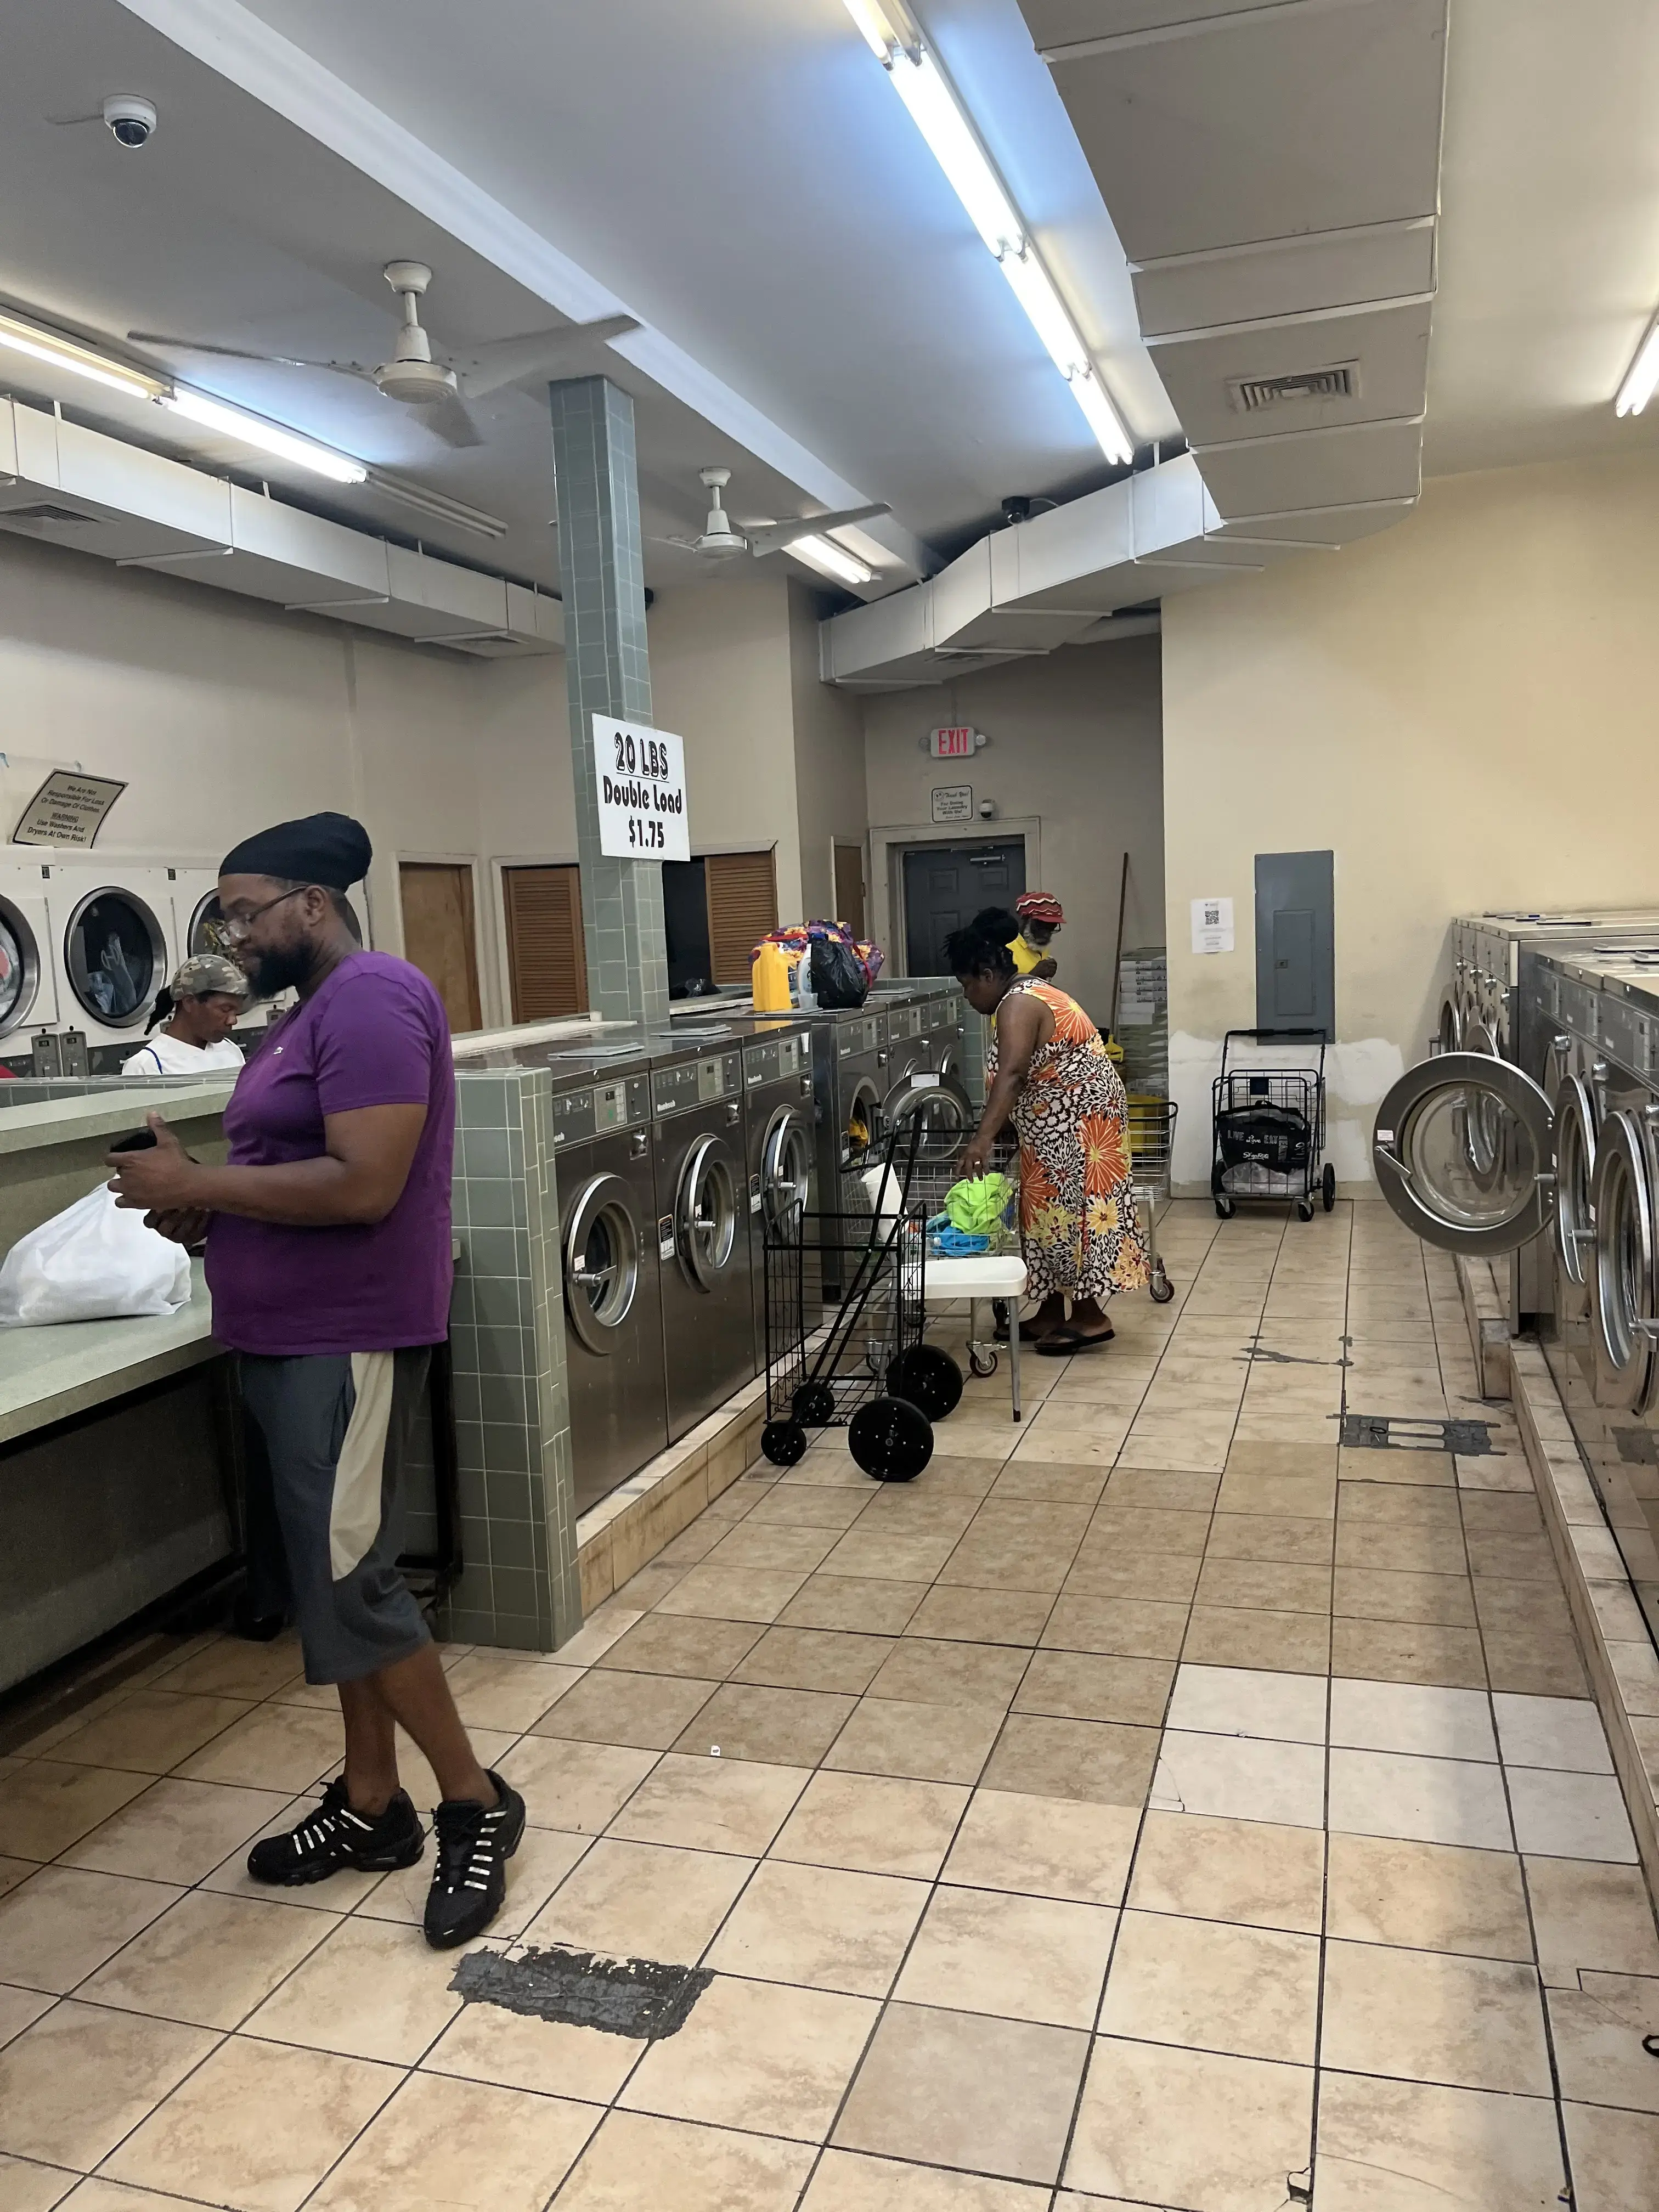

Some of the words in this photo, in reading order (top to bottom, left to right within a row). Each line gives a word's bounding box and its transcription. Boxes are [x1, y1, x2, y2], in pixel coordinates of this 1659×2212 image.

[938, 729, 969, 755] EXIT
[614, 732, 635, 774] 20
[640, 738, 668, 780] LBS
[47, 790, 81, 800] Responsible
[603, 775, 650, 810] Double
[653, 784, 682, 815] Load
[49, 799, 71, 808] Damage
[51, 812, 80, 823] WARNING
[49, 821, 73, 830] Washers
[629, 815, 665, 848] $1.75
[27, 826, 48, 836] Dryers
[70, 834, 87, 842] Risk!
[1227, 1130, 1244, 1141] LIVE
[1263, 1135, 1278, 1144] EAT
